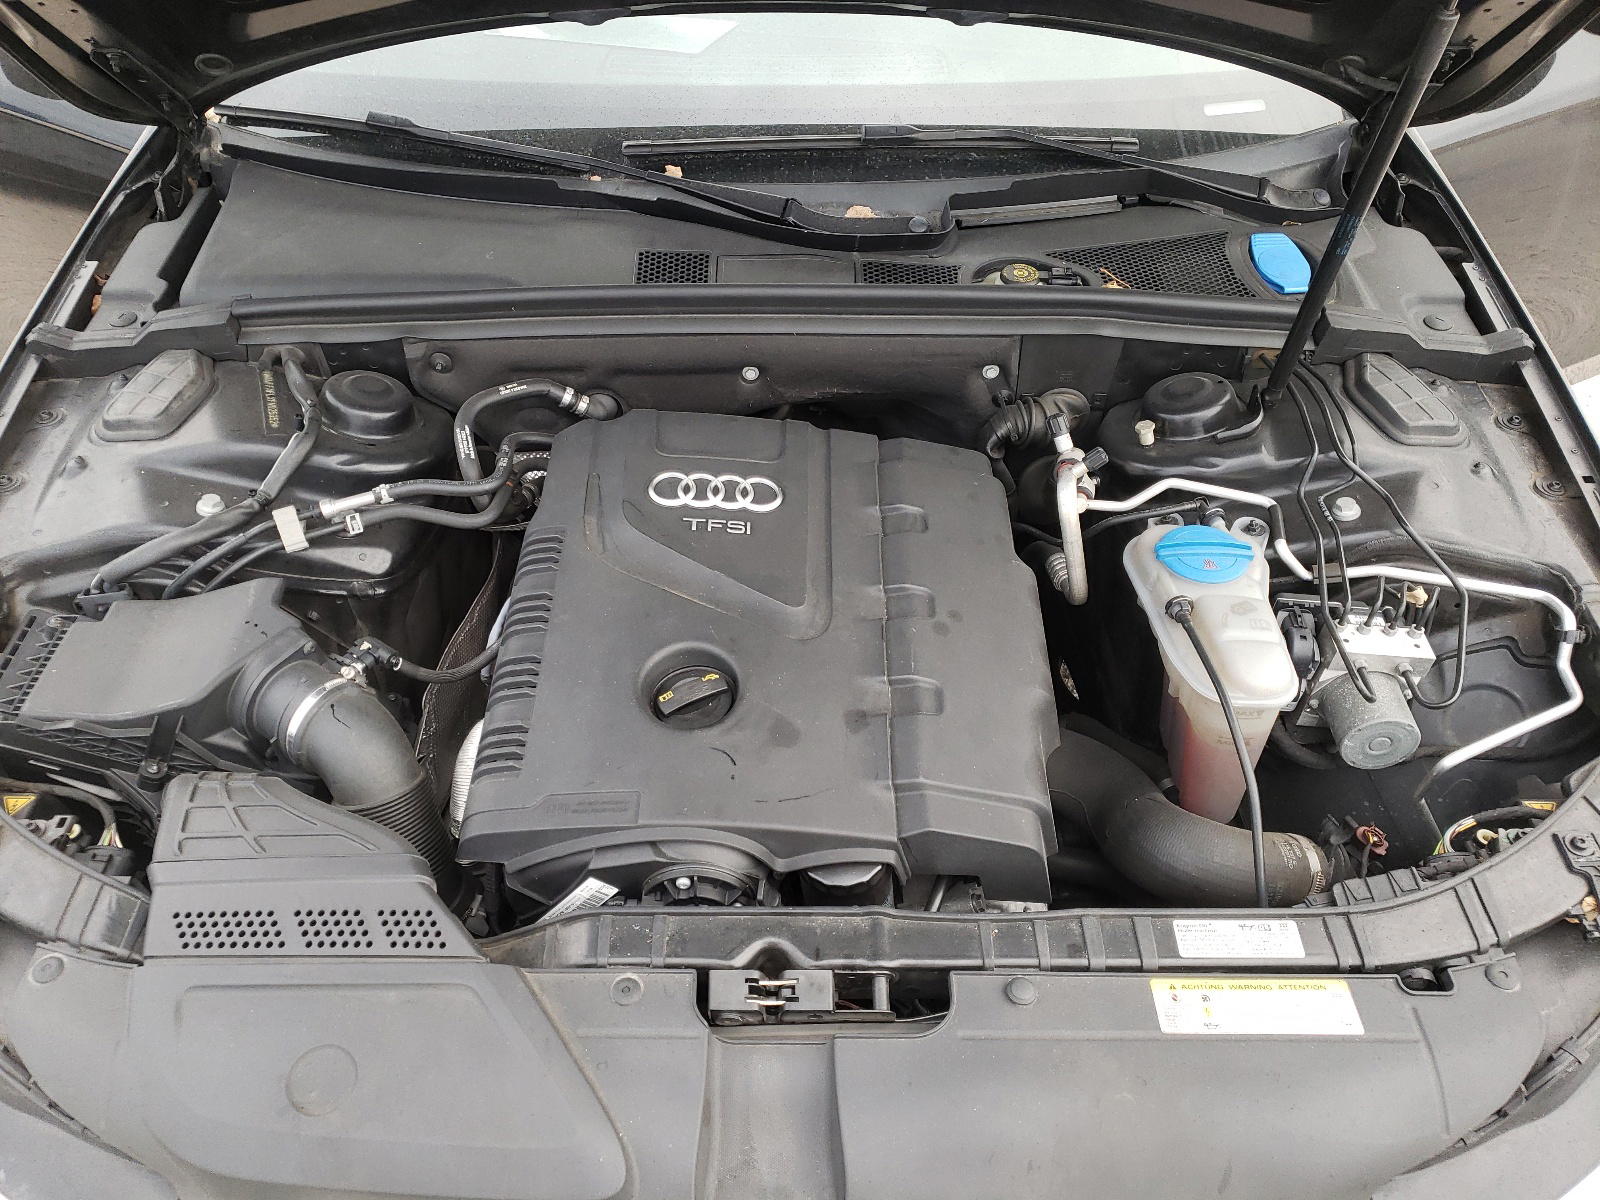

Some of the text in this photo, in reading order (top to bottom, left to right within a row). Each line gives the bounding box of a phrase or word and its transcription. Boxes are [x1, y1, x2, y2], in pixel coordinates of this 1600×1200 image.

[682, 517, 751, 535] TFSI
[1181, 983, 1327, 991] ACHTUNG WARNING ATTENTION
